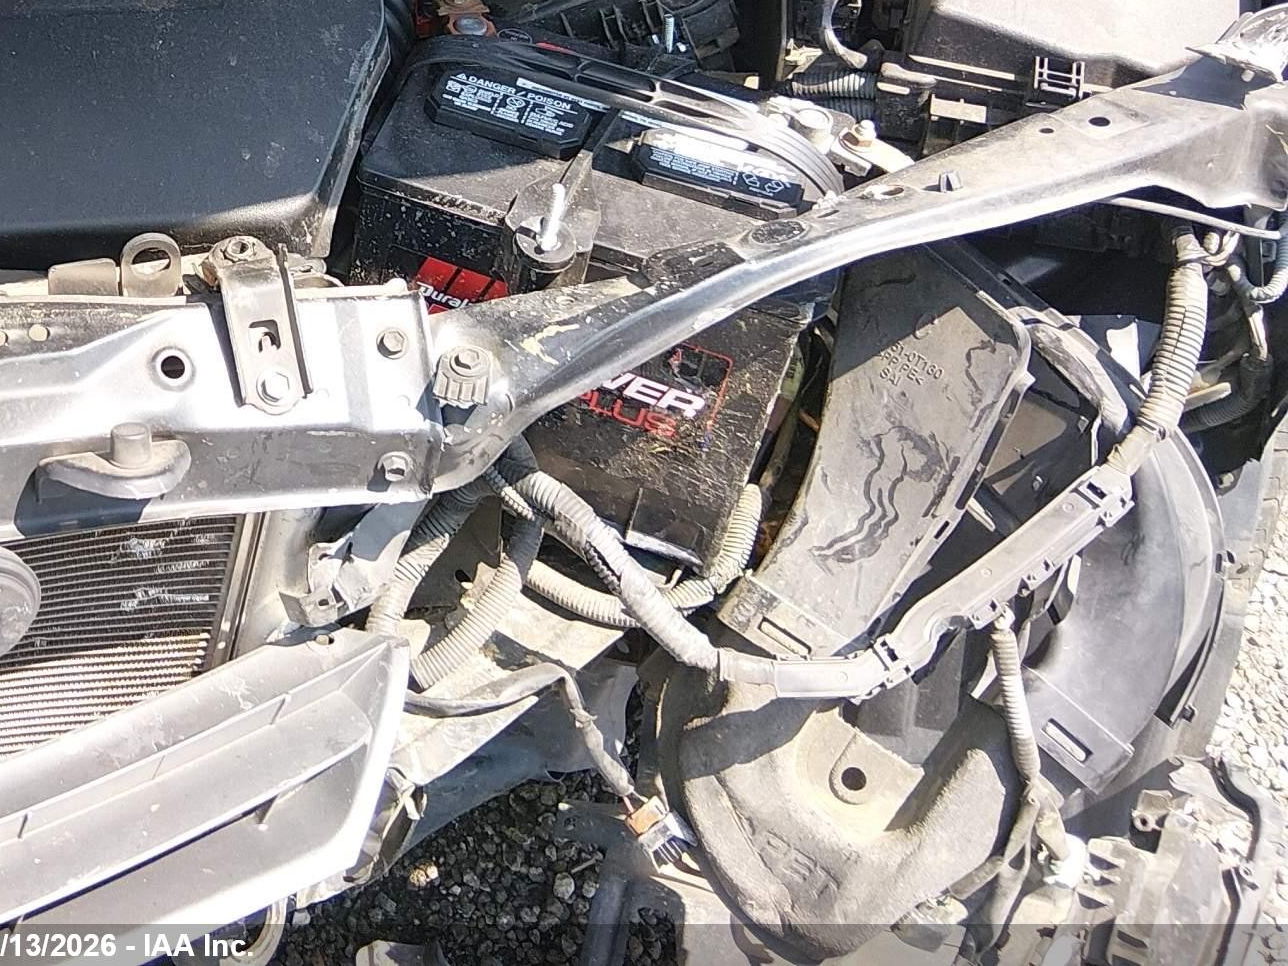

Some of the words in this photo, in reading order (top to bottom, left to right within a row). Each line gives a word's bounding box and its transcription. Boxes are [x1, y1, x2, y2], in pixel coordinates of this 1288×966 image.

[468, 75, 517, 95] DANGER
[527, 92, 572, 111] POISON
[416, 281, 473, 310] Dural
